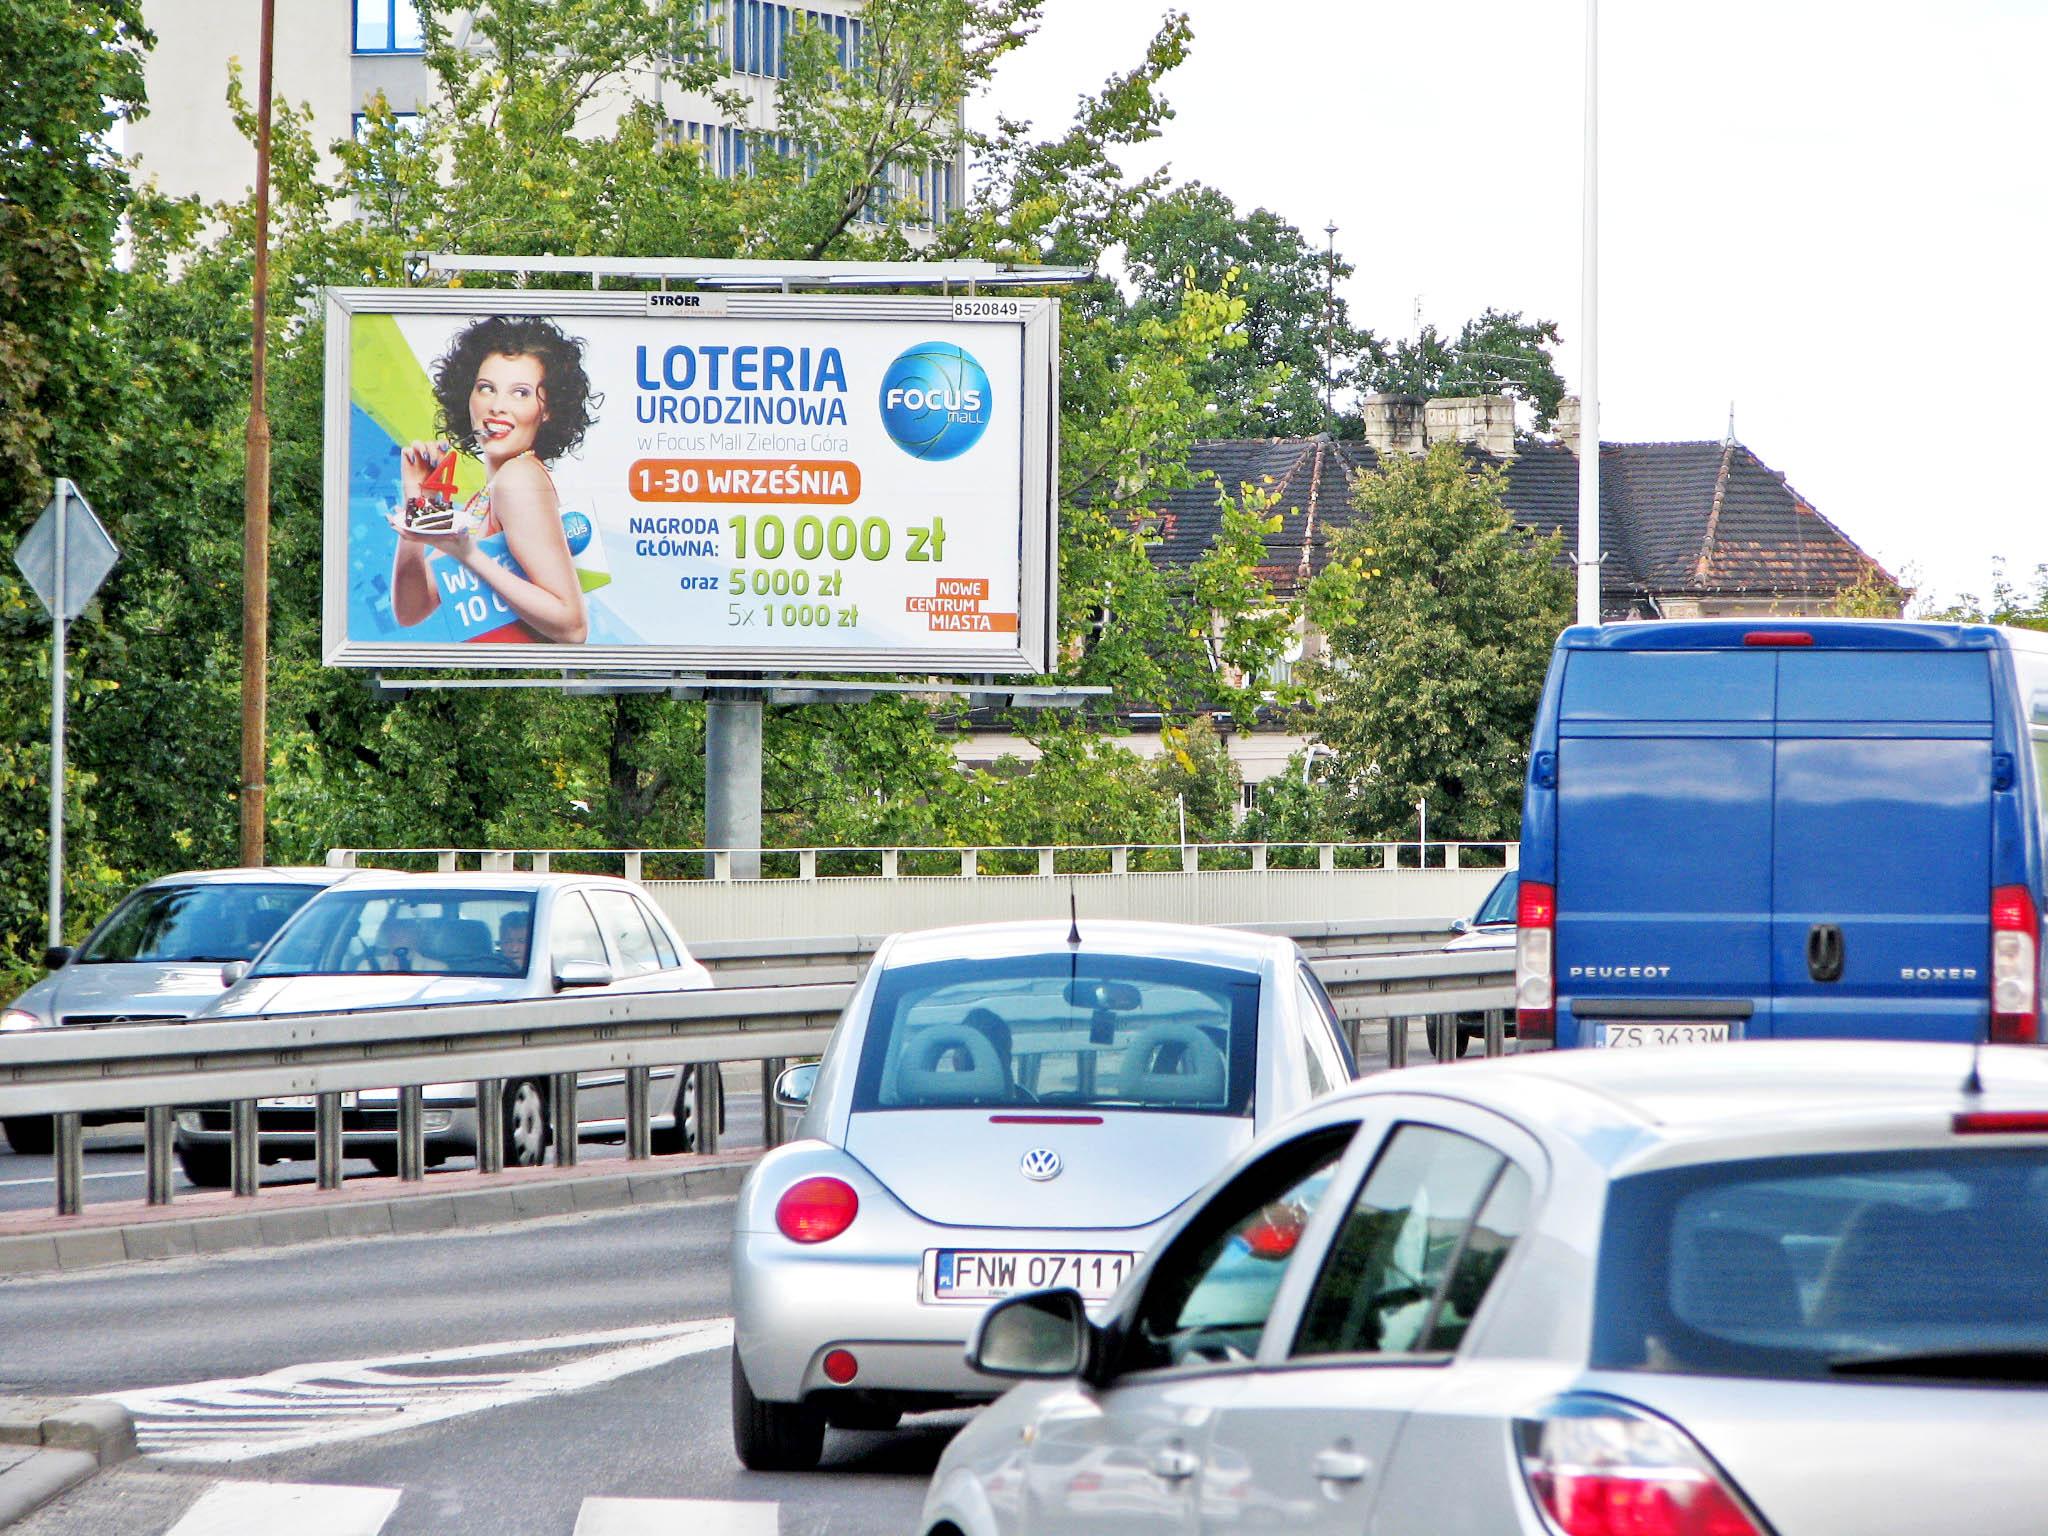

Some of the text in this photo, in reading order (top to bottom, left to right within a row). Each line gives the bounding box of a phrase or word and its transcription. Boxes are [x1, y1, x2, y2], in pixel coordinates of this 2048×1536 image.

[651, 295, 700, 306] STRÖER
[954, 303, 1017, 315] 8520849
[636, 345, 848, 392] LOTERIA
[887, 388, 981, 411] FOCUS
[636, 396, 848, 425] URODZINOWA
[637, 432, 848, 452] w Focus Mall Zielona Góra
[638, 464, 849, 496] 1-30 WRZEŚNIA
[629, 517, 720, 535] NAGRODA
[635, 536, 719, 557] GŁÓWNA:
[905, 515, 946, 562] zł
[680, 577, 719, 590] oraz
[818, 569, 843, 597] zł
[939, 582, 982, 596] NOWE
[728, 603, 755, 627] 5x
[837, 604, 859, 628] zł
[909, 598, 975, 613] CENTRUM
[931, 614, 992, 631] MIASTA
[1570, 966, 1671, 978] PEUGEOT
[1901, 968, 1977, 980] BOXER
[1610, 1027, 1643, 1048] ZS
[956, 1256, 1123, 1289] FNW 07111
